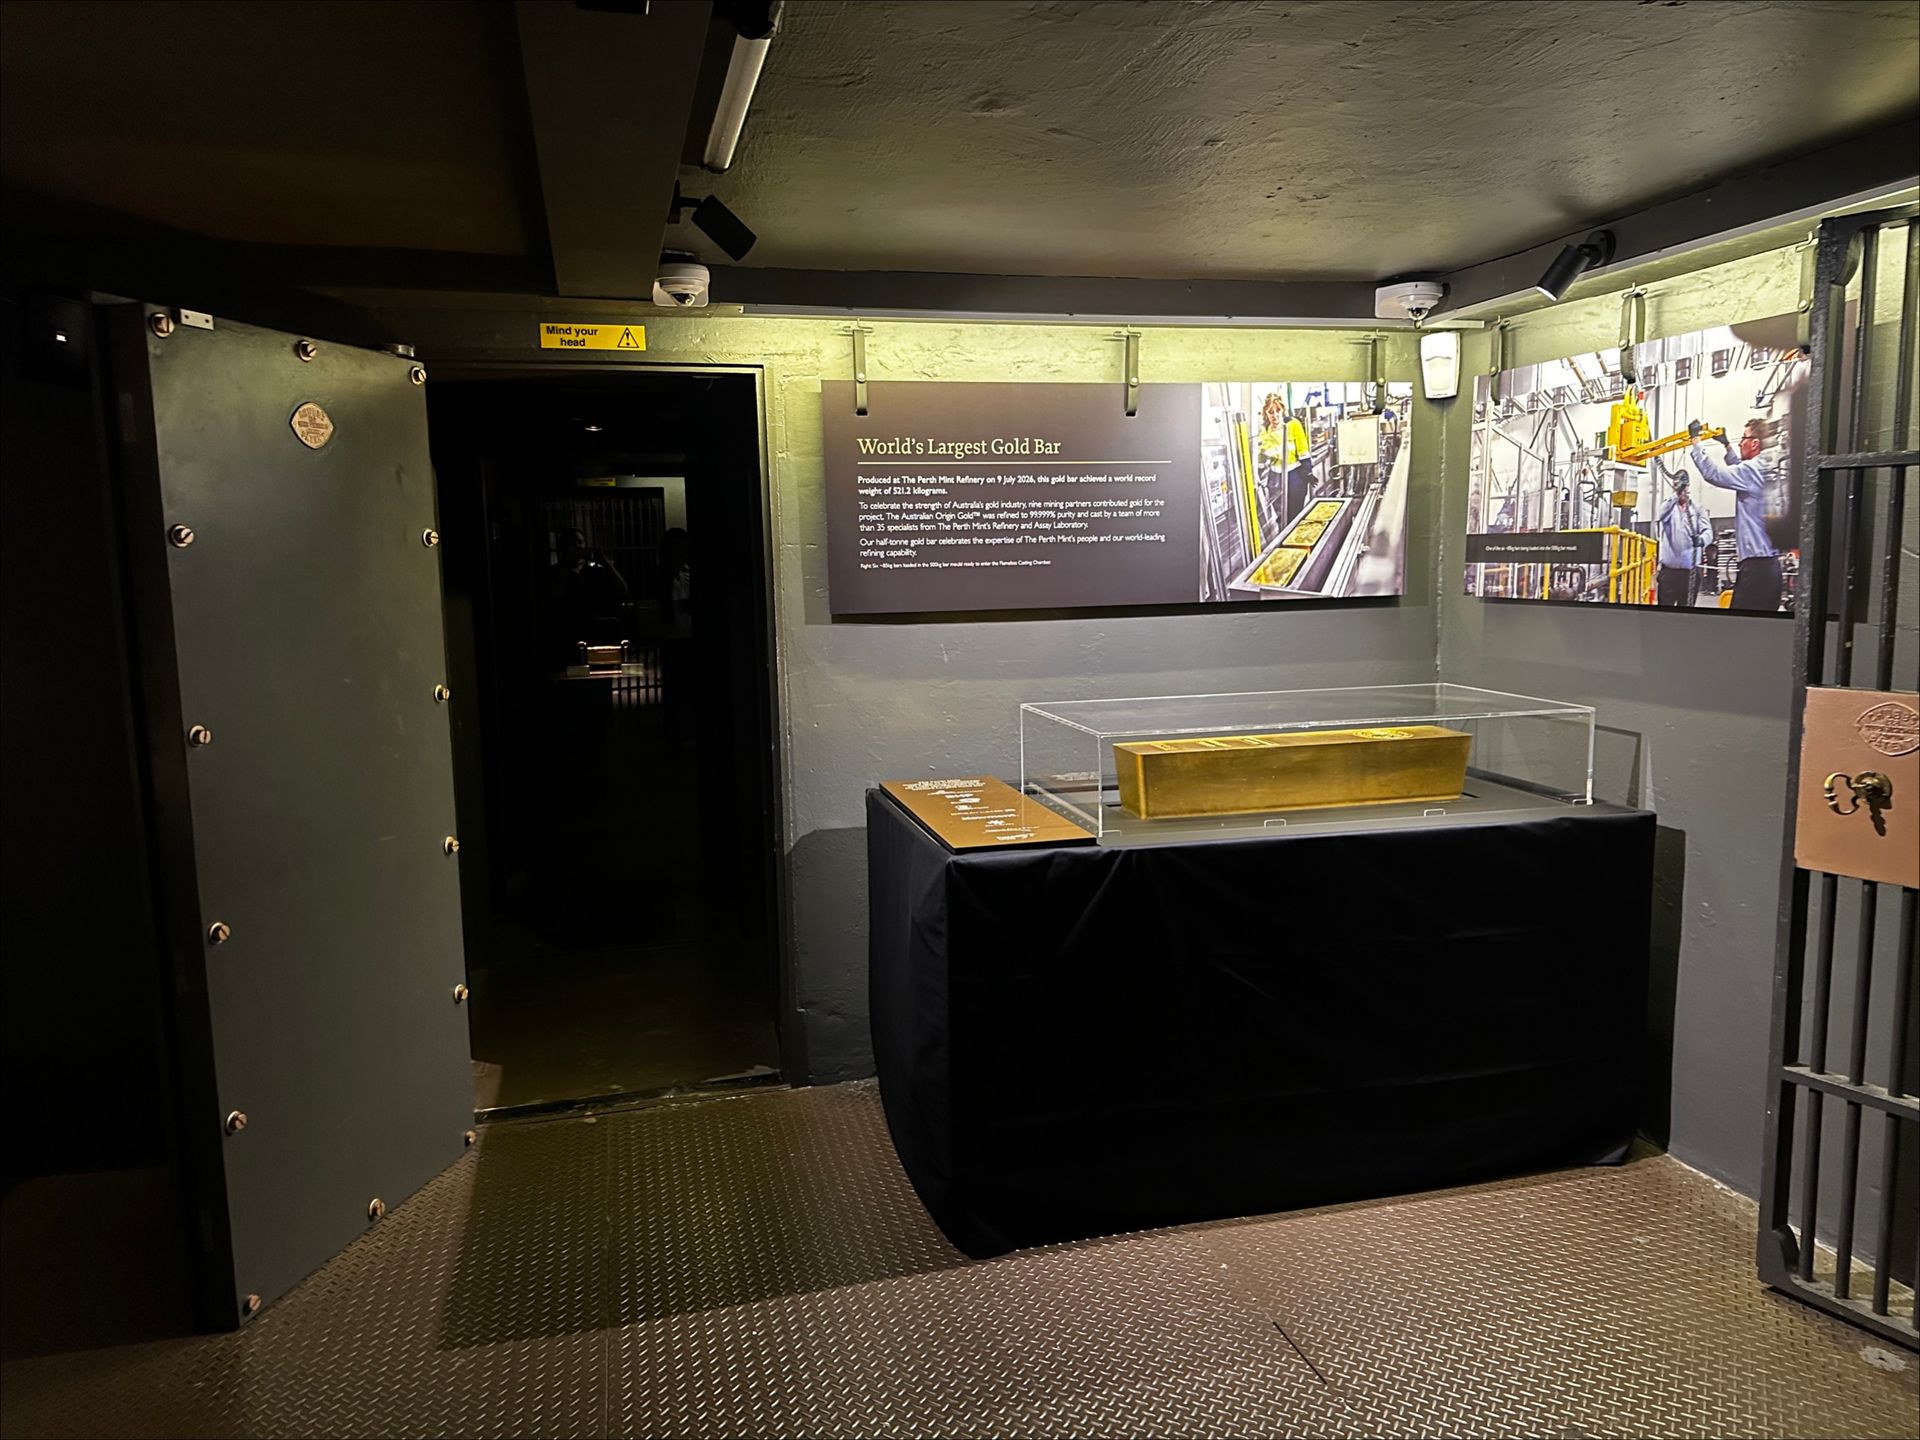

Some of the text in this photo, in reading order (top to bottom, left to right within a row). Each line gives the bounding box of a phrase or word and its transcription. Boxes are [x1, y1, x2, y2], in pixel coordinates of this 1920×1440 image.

[546, 326, 598, 336] Mind your
[560, 338, 586, 346] head
[857, 438, 1061, 459] World's Largest Gold Bar
[858, 476, 891, 484] Produced
[956, 475, 984, 485] Refinery
[1003, 475, 1016, 485] July
[1017, 475, 1036, 484] 2026,
[1037, 475, 1049, 483] this
[1051, 475, 1065, 484] gold
[858, 487, 882, 496] weight
[913, 487, 948, 496] kilograms.
[870, 502, 900, 510] celebrate
[915, 501, 942, 511] strength
[944, 501, 951, 509] of
[952, 501, 984, 509] Australia's
[985, 501, 999, 510] gold
[1001, 500, 1027, 510] industry,
[1043, 500, 1064, 509] mining
[1065, 500, 1091, 509] partners
[1129, 500, 1143, 508] gold
[859, 513, 884, 522] project.
[886, 512, 899, 520] The
[900, 512, 934, 520] Australian
[935, 512, 956, 522] Origin
[1057, 511, 1075, 520] purity
[1104, 510, 1112, 519] by
[887, 523, 918, 532] specialists
[937, 523, 951, 531] The
[972, 522, 990, 530] Mint's
[992, 522, 1019, 531] Refinery
[1034, 522, 1052, 530] Assay
[1053, 521, 1088, 530] Laboratory.
[876, 538, 908, 546] half-tonne
[910, 538, 924, 547] gold
[938, 537, 971, 545] celebrates
[972, 537, 983, 545] the
[985, 536, 1014, 546] expertise
[1016, 536, 1024, 544] of
[1057, 535, 1076, 543] Mint's
[1077, 535, 1098, 544] people
[1125, 533, 1166, 542] world-leading
[860, 548, 917, 558] refining capability.
